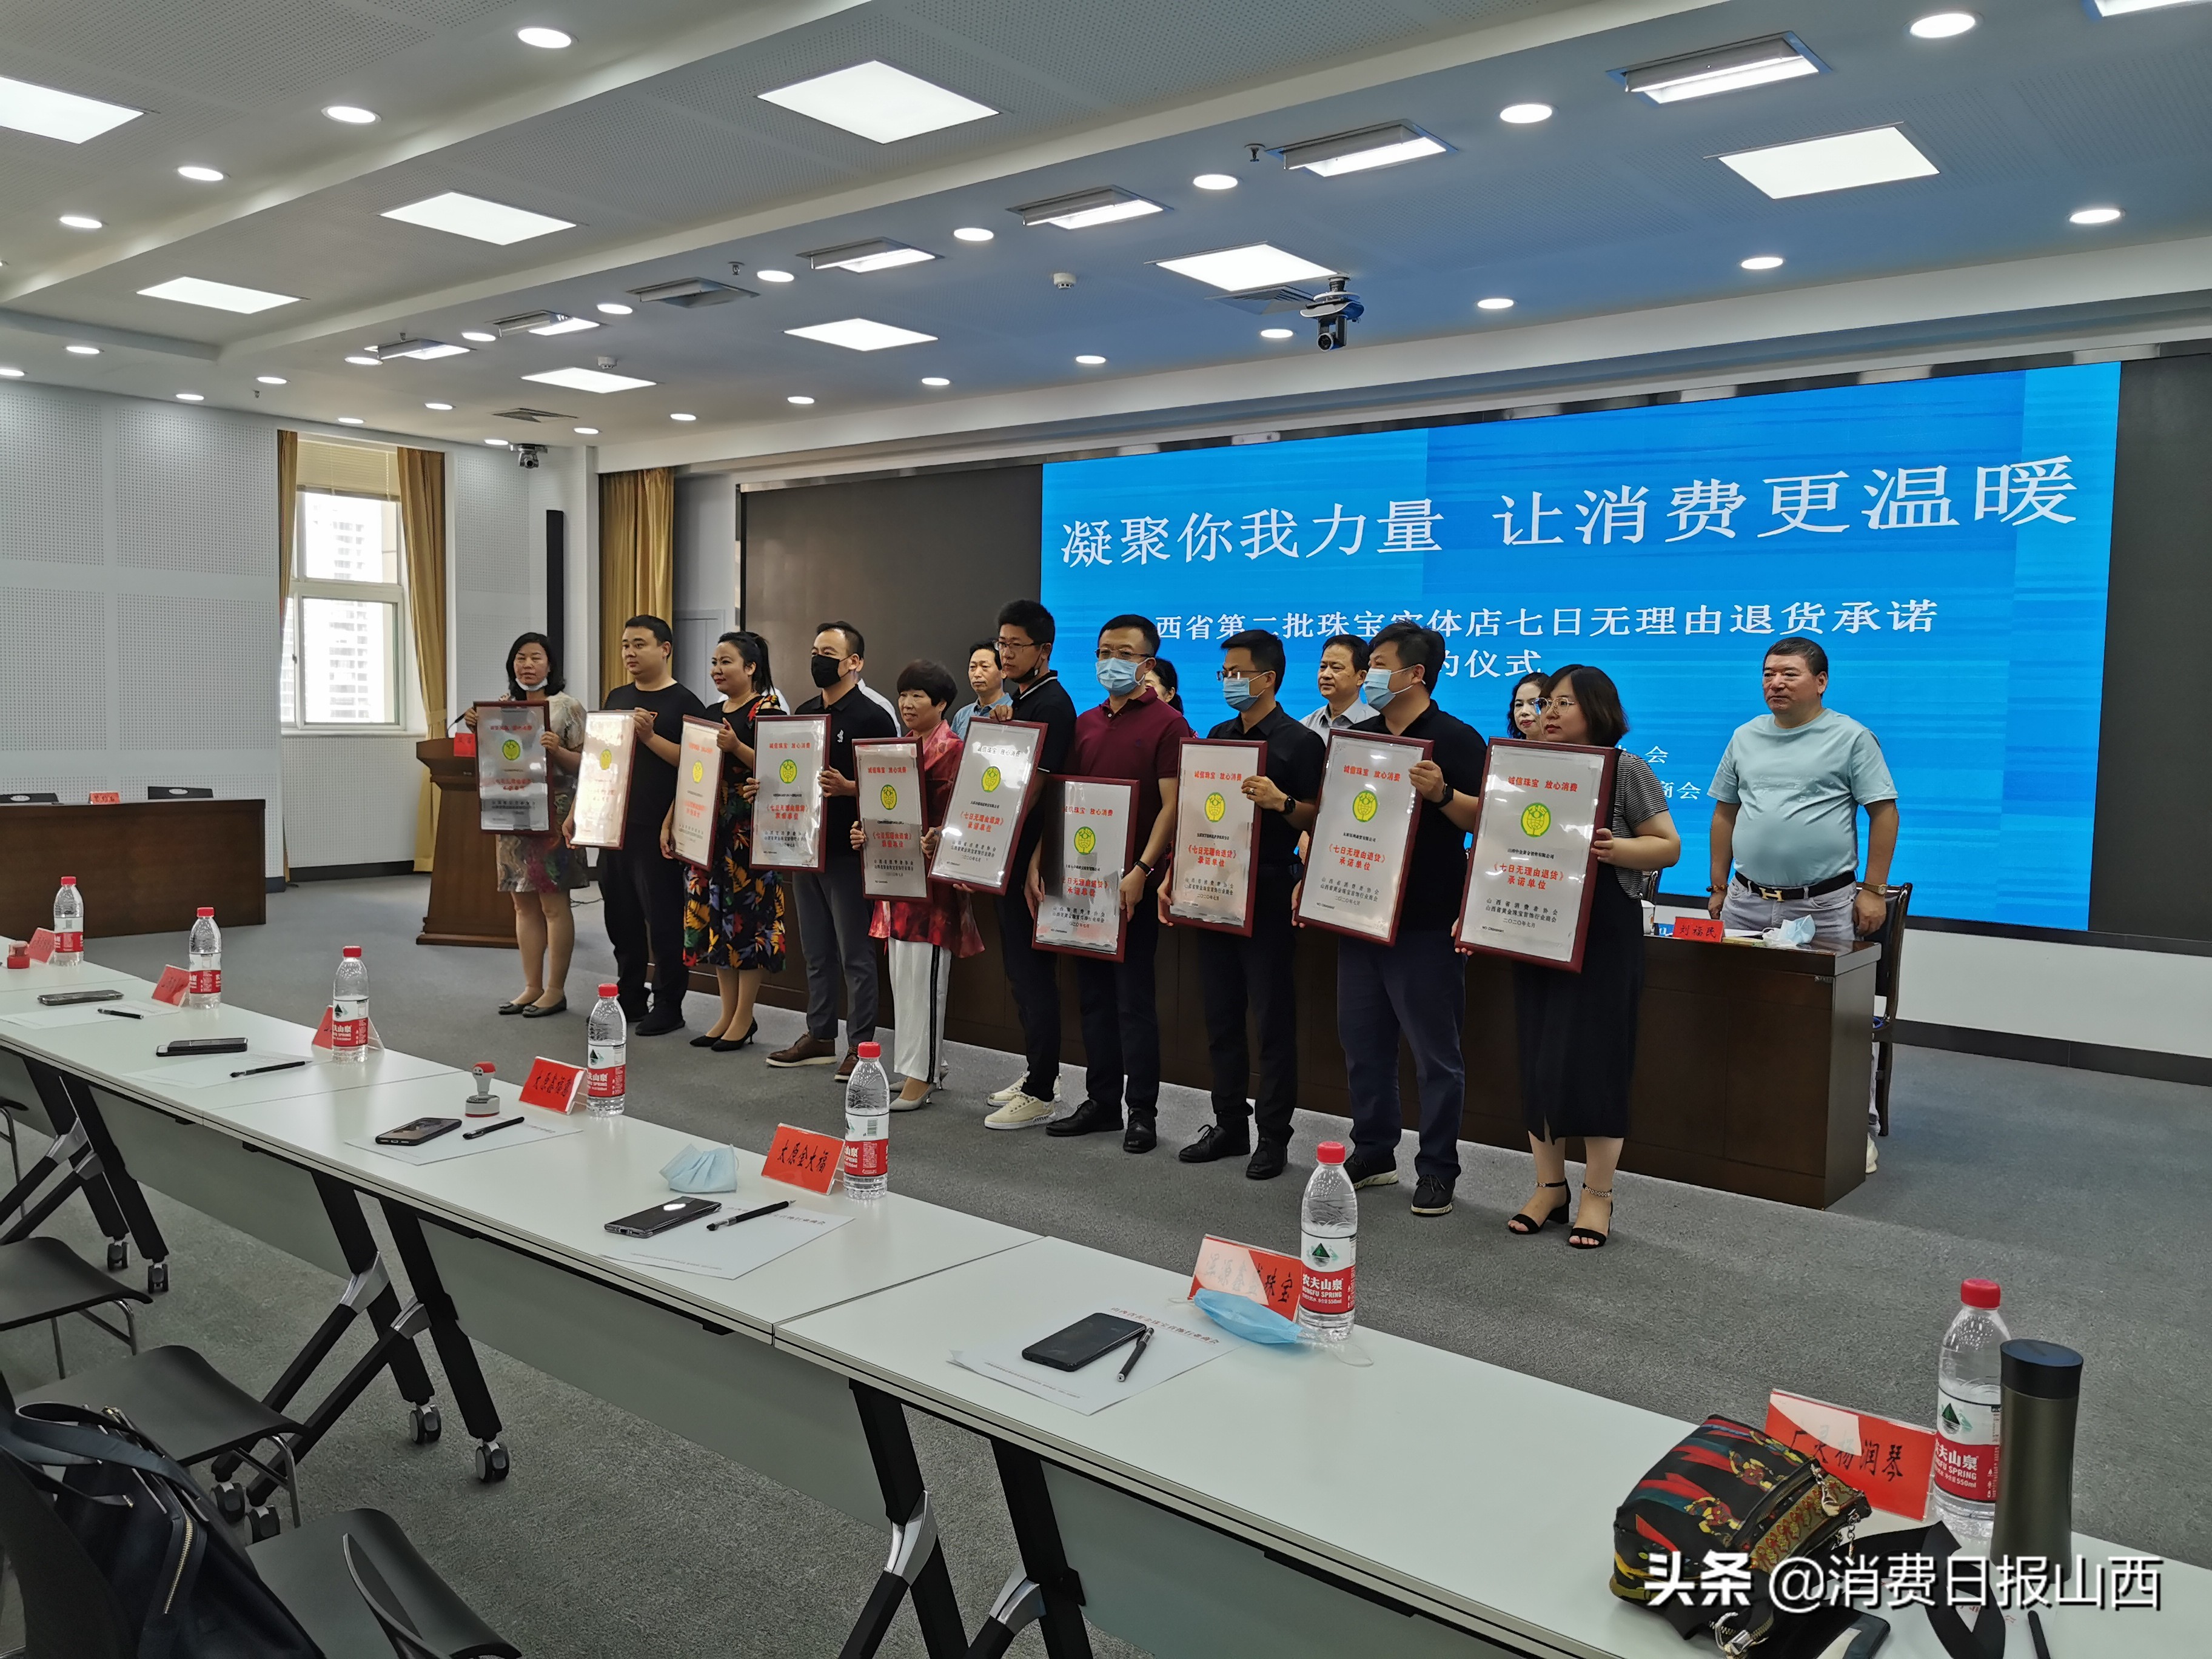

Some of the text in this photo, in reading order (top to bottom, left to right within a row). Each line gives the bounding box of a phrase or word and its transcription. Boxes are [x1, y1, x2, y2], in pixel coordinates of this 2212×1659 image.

[1061, 455, 2077, 568] 凝聚你我力量 让消费更温暖
[1507, 776, 1578, 793] 诚信珠宝 放心消费
[1493, 862, 1564, 881] 《七日无理由退货》
[1507, 875, 1546, 890] 承诺单位
[1680, 925, 1716, 939] 刘福民
[1302, 1273, 1342, 1291] 农夫山泉
[1948, 1465, 1977, 1481] SPRING
